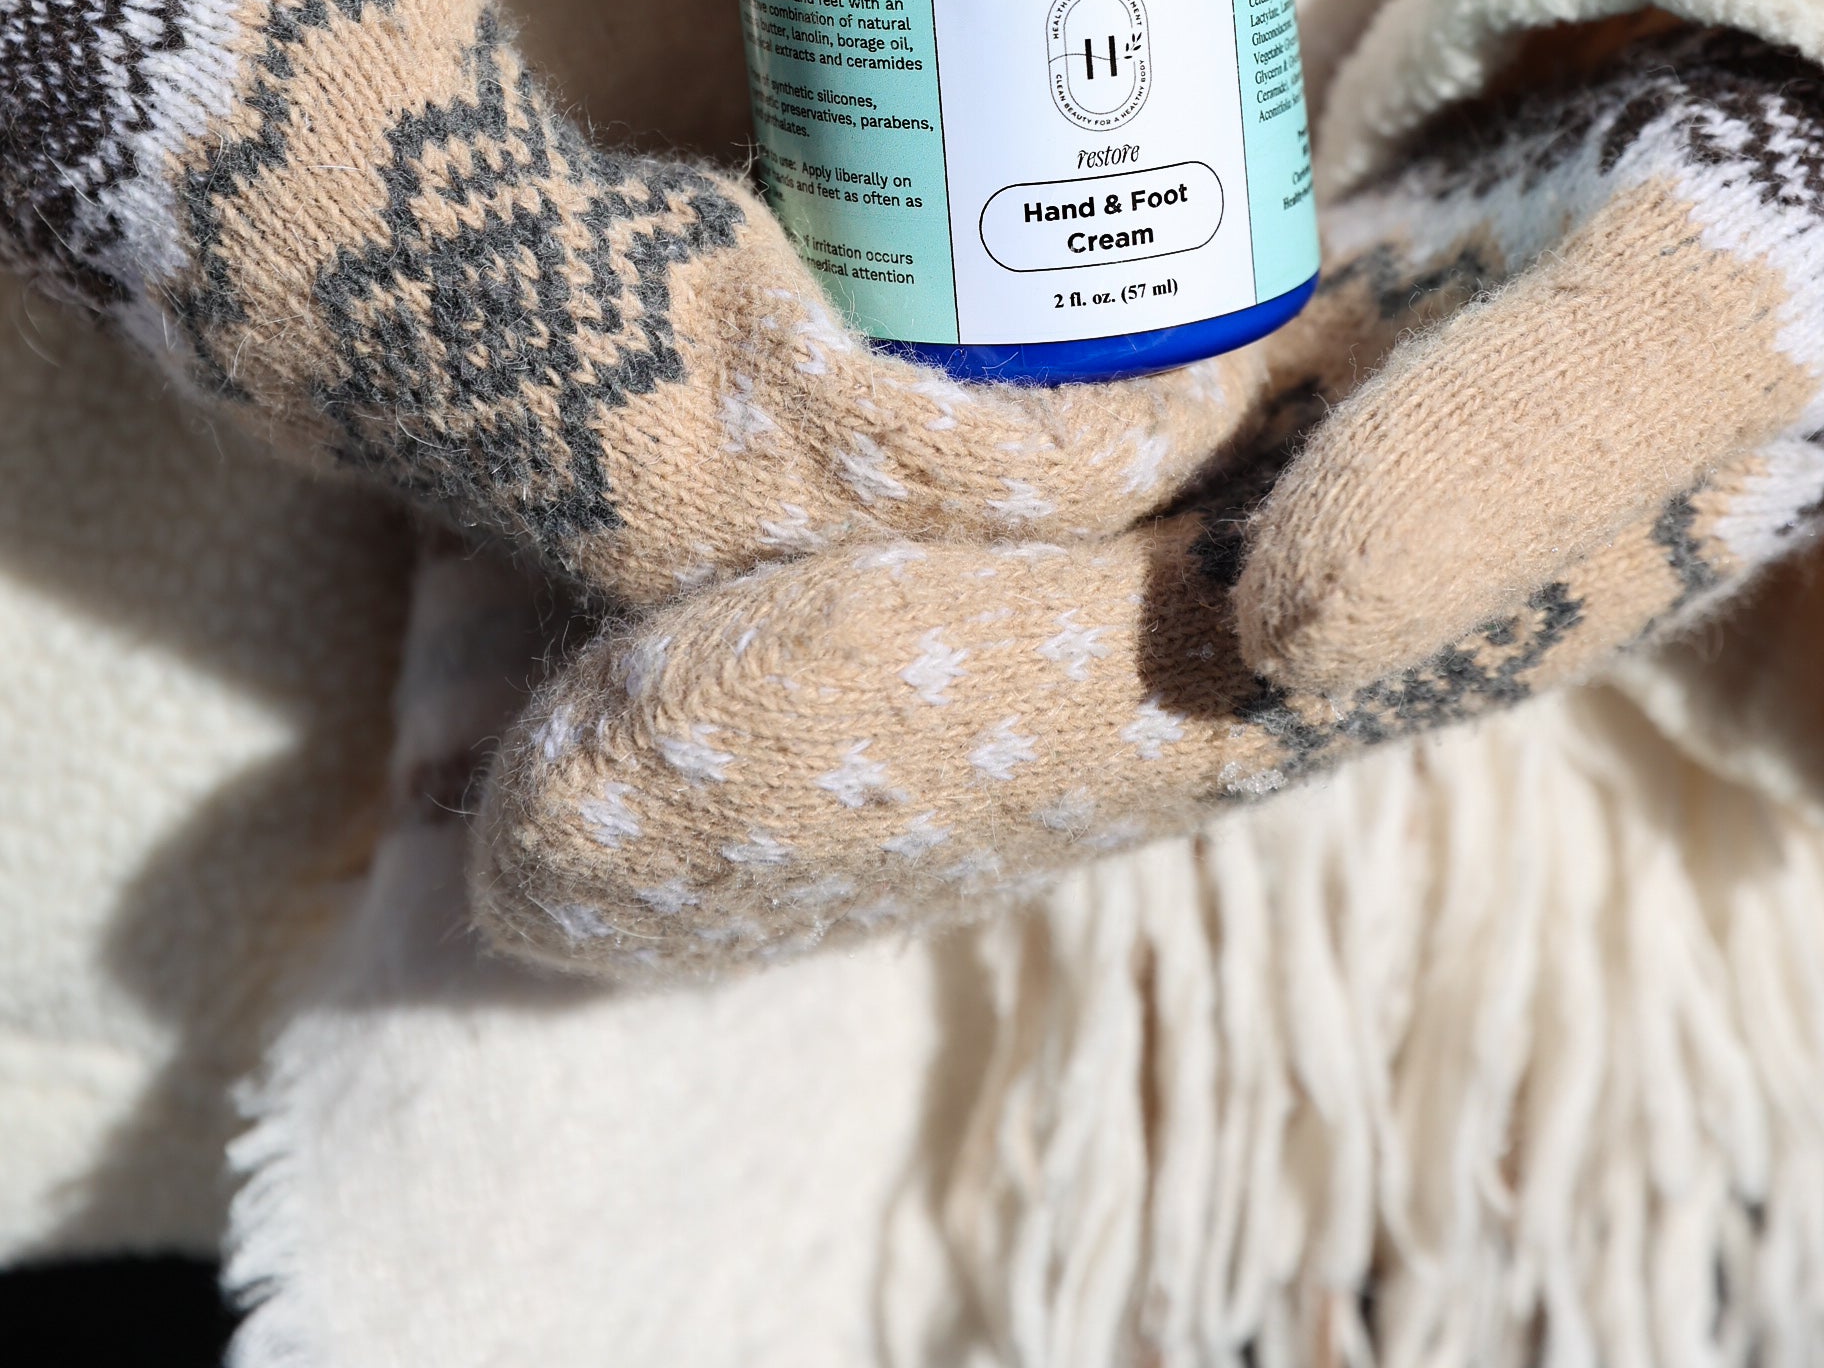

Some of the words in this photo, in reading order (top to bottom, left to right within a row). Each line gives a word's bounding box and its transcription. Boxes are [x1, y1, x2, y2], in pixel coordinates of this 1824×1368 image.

[769, 5, 835, 28] combination
[839, 13, 853, 28] of
[858, 16, 912, 30] natural
[885, 0, 904, 11] an
[760, 20, 789, 40] butter,
[792, 26, 833, 48] lanolin,
[837, 33, 885, 52] borage
[890, 36, 914, 53] oil,
[775, 43, 816, 63] extracts
[820, 53, 842, 66] and
[846, 56, 923, 70] ceramides
[1084, 35, 1118, 80] H
[771, 80, 814, 101] synthetic
[817, 89, 877, 110] silicones,
[1056, 74, 1067, 102] CLEAN
[1064, 103, 1091, 124] BEAUTY
[1121, 86, 1145, 118] HEALTHY
[781, 102, 856, 128] preservatives,
[860, 115, 934, 131] parabens,
[1077, 144, 1140, 169] restore
[802, 161, 832, 183] Apply
[835, 167, 888, 189] liberally
[893, 176, 912, 188] on
[797, 180, 815, 194] and
[817, 183, 841, 200] feet
[844, 191, 858, 202] as
[863, 191, 901, 206] often
[905, 196, 923, 208] as
[1023, 196, 1095, 223] Hand
[1103, 194, 1122, 215] &
[1131, 183, 1188, 212] Foot
[812, 236, 862, 260] irritation
[866, 250, 914, 265] occurs
[1067, 227, 1154, 254] Cream
[806, 256, 849, 277] medical
[852, 267, 915, 284] attention
[1053, 294, 1065, 309] 2
[1069, 291, 1087, 307] fl.
[1092, 293, 1116, 305] oz.
[1120, 284, 1146, 304] (57
[1152, 278, 1179, 297] ml)
